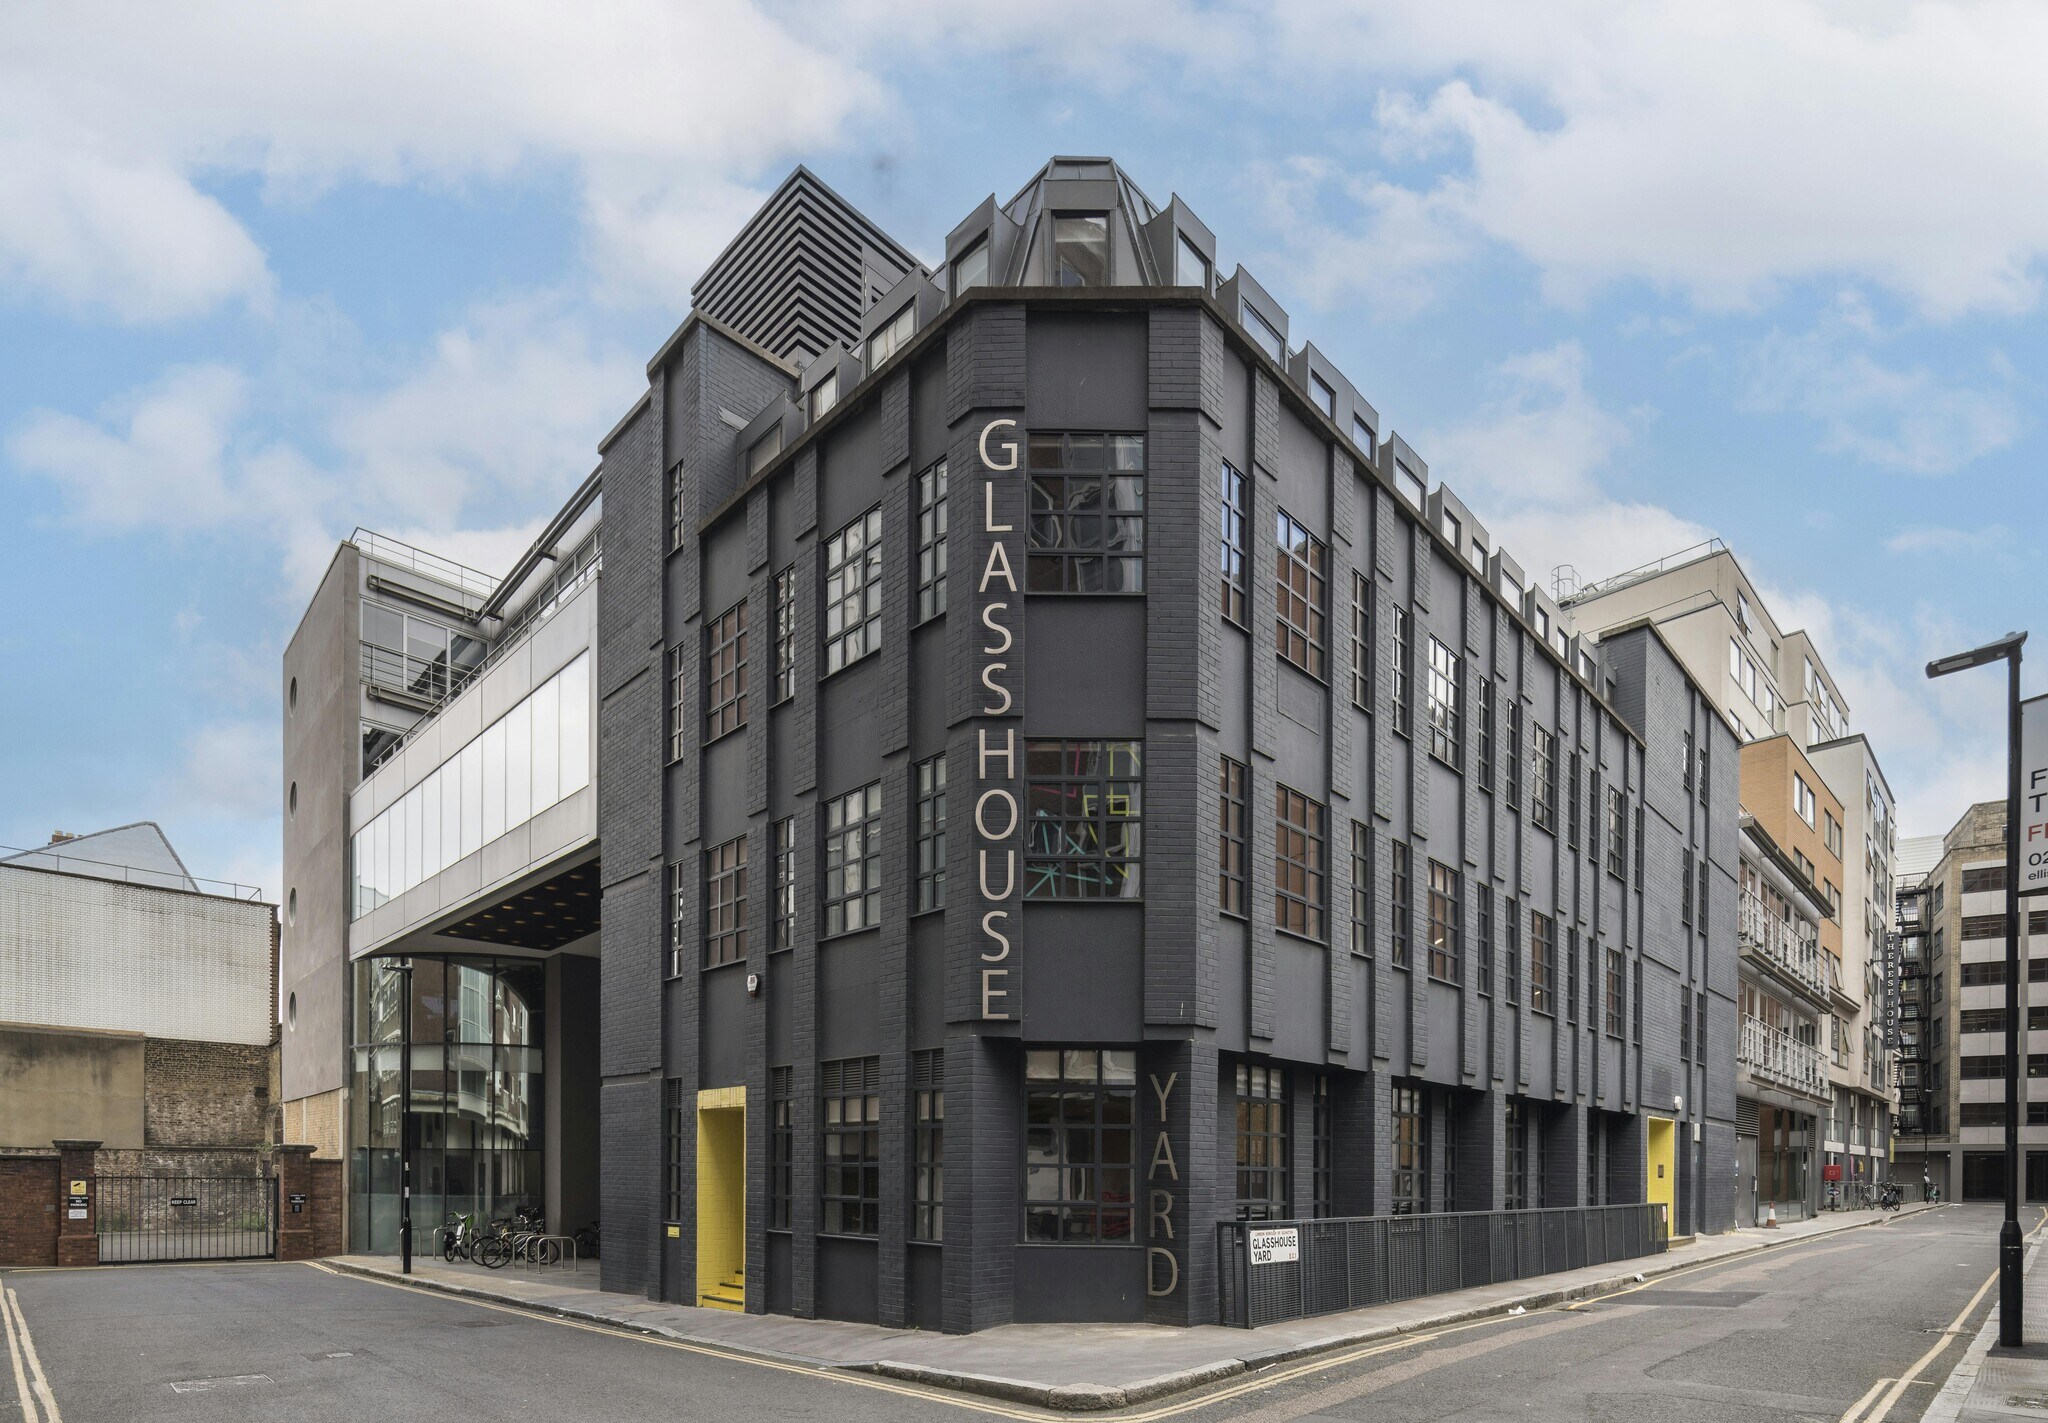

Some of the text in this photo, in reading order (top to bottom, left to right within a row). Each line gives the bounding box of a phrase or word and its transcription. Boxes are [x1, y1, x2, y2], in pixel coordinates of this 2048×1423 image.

[975, 418, 1018, 1020] GLASSHOUSE
[2028, 823, 2048, 842] F
[1886, 934, 1895, 1045] THERESE HOUSE
[1148, 1072, 1179, 1297] YARD
[1252, 1236, 1297, 1249] GLASSHOUSE
[1253, 1250, 1272, 1262] YARD
